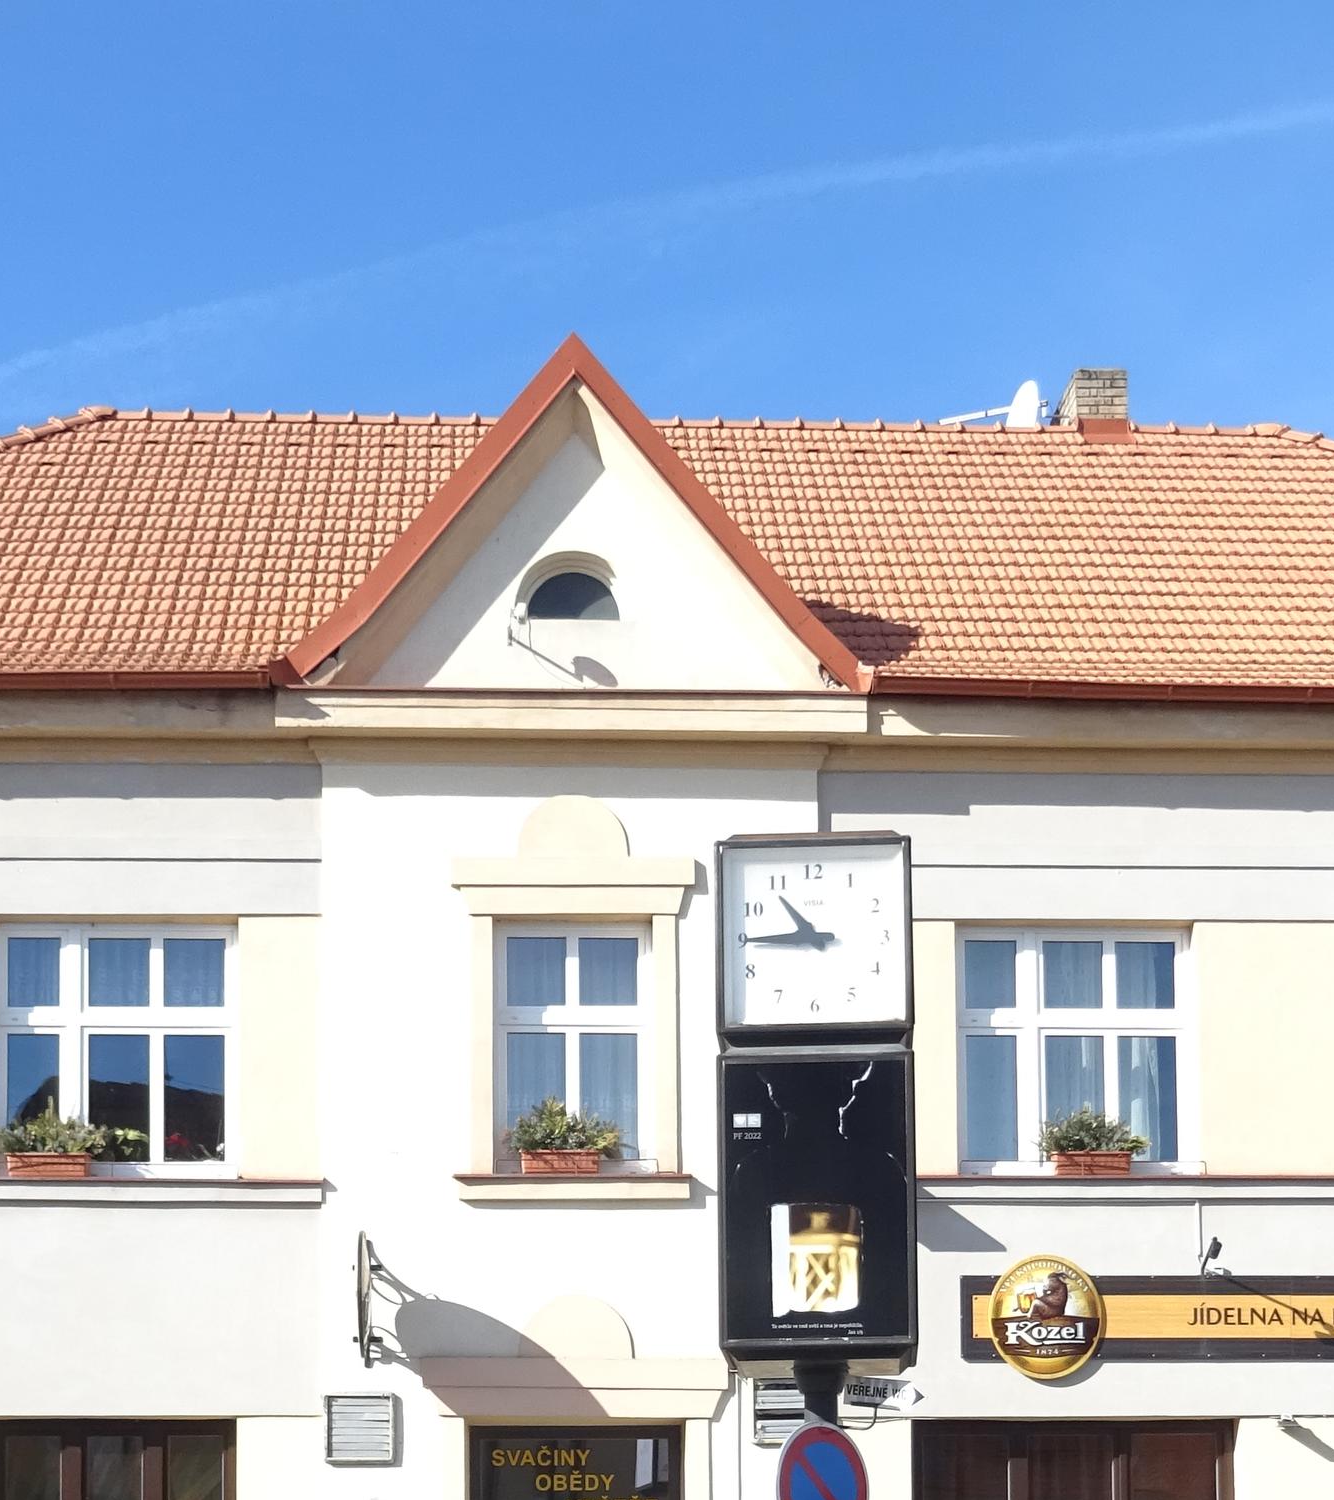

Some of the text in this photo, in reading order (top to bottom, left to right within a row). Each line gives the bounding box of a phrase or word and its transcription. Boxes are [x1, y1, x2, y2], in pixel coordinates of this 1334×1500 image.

[803, 863, 823, 880] 12
[769, 875, 787, 891] 11
[846, 873, 854, 888] 1
[743, 901, 764, 918] 10
[870, 898, 880, 913] 2
[737, 932, 748, 949] 9
[880, 930, 890, 945] 3
[745, 963, 756, 980] 8
[870, 961, 881, 976] 4
[773, 989, 783, 1004] 7
[846, 987, 857, 1002] 5
[810, 998, 820, 1013] 6
[733, 1132, 763, 1140] PF 2022
[1187, 1302, 1284, 1326] JÍDELNA
[1291, 1307, 1325, 1326] NA
[1004, 1321, 1086, 1346] Kozel
[846, 1382, 889, 1399] VEŘEJNÉ
[491, 1445, 591, 1467] SVAČINY
[535, 1470, 615, 1492] OBĚDY
